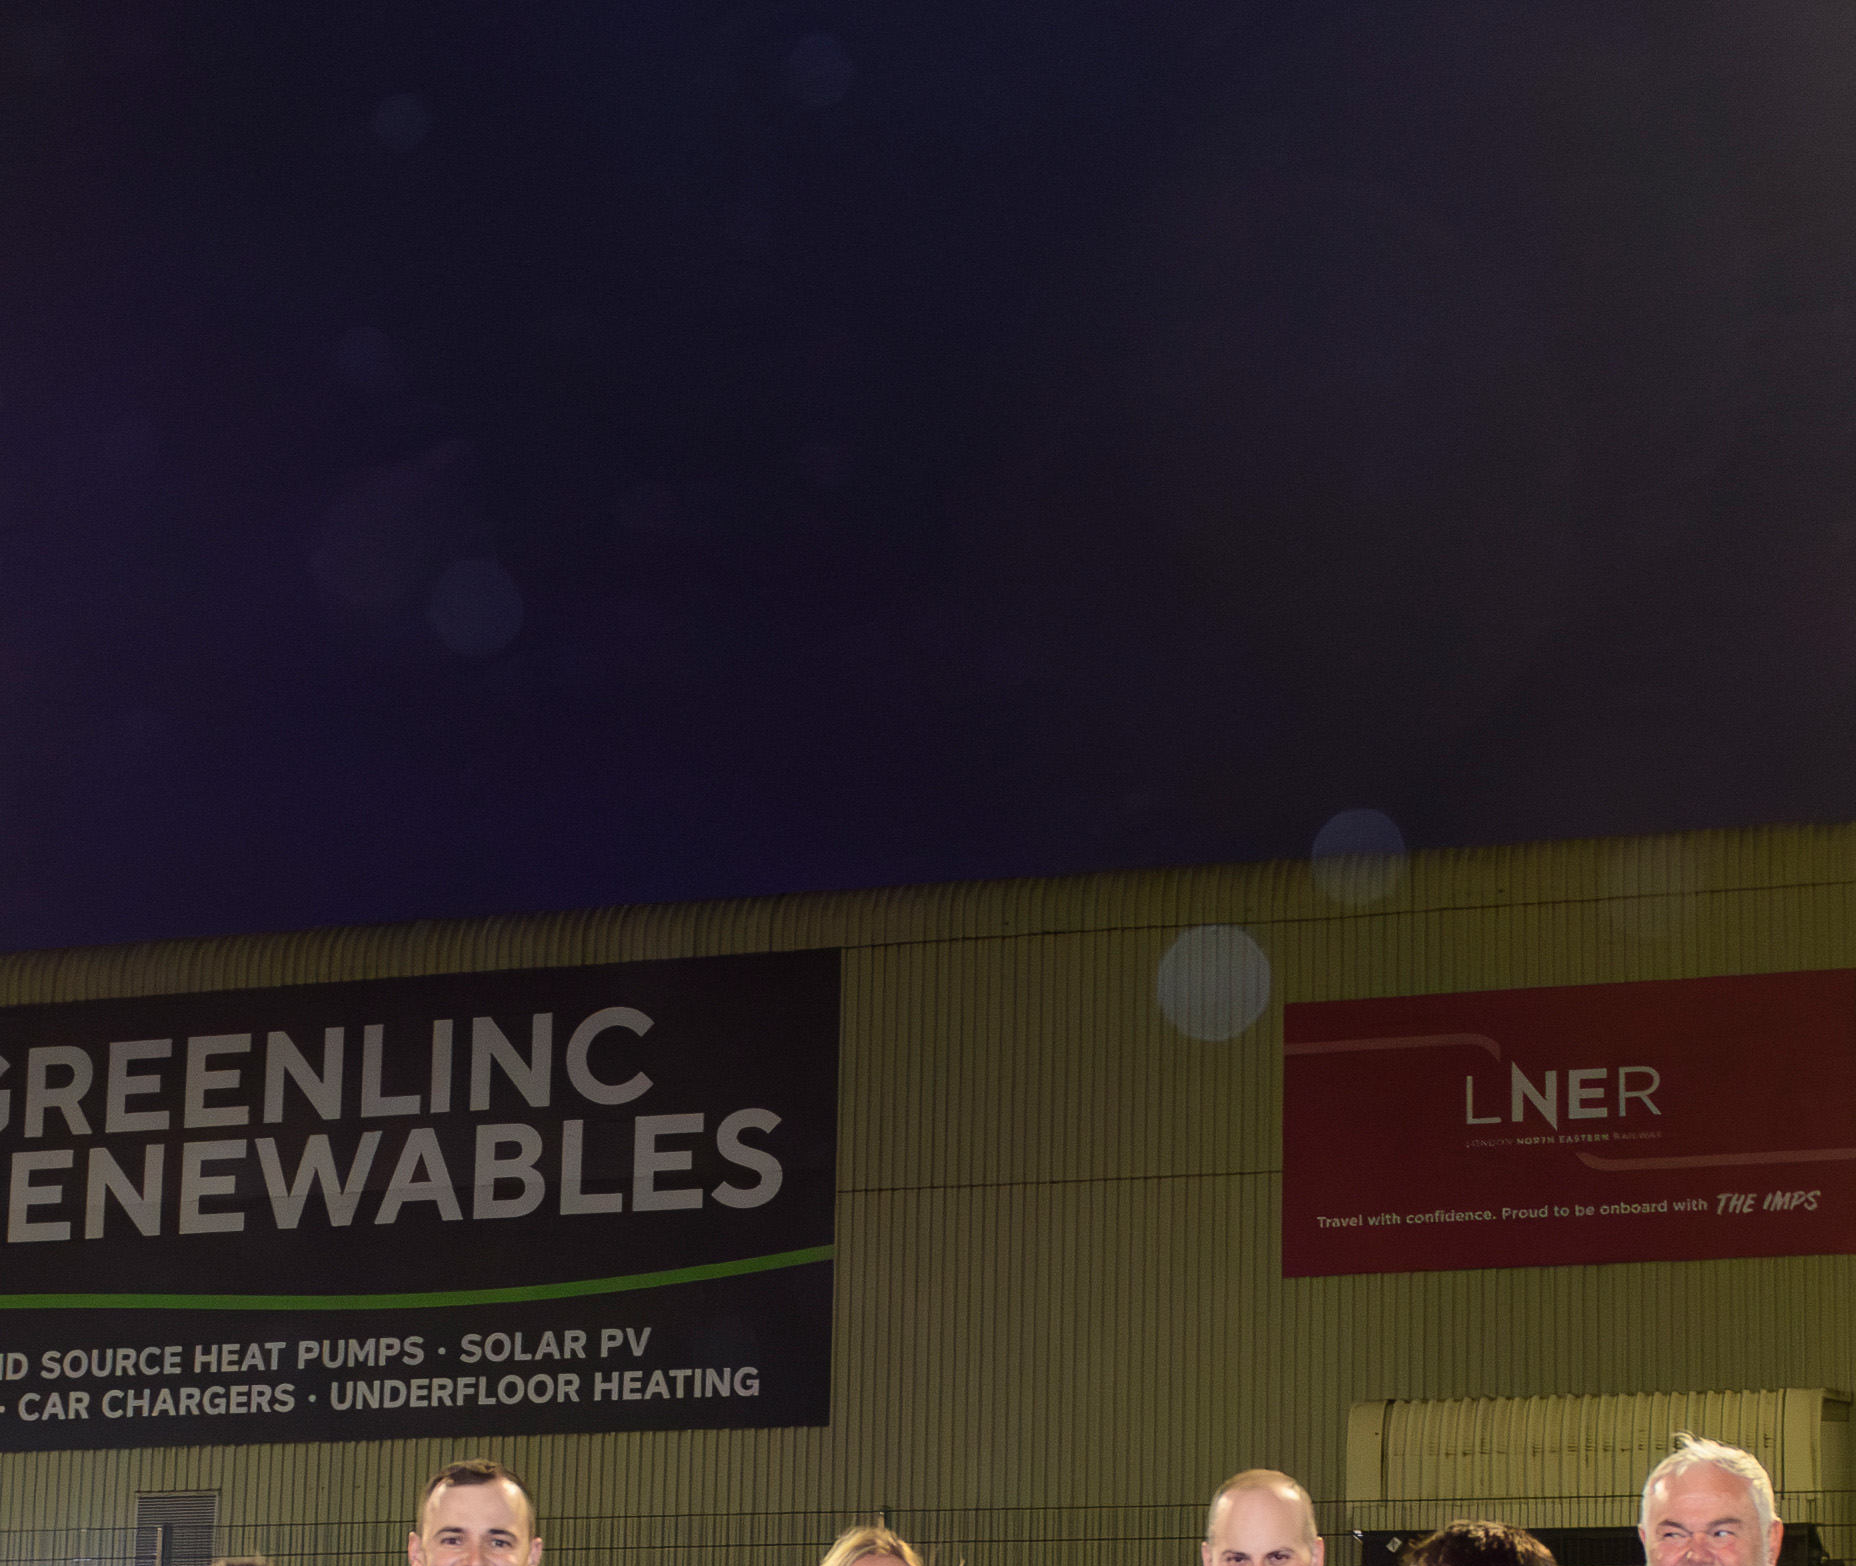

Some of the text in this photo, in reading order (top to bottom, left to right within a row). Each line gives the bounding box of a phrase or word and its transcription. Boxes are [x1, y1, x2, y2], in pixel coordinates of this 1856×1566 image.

[1465, 1061, 1663, 1131] LNER
[1317, 1189, 1822, 1229] Travel with confidence. Proud to be onboard with THE IMPS
[40, 1345, 183, 1380] SOURCE
[193, 1341, 287, 1374] HEAT
[297, 1335, 425, 1370] PUMPS
[459, 1329, 587, 1364] SOLAR
[600, 1326, 652, 1358] PV
[18, 1389, 91, 1422] CAR
[101, 1382, 296, 1419] CHARGERS
[330, 1373, 580, 1411] UNDERFLOOR
[593, 1366, 760, 1401] HEATING
